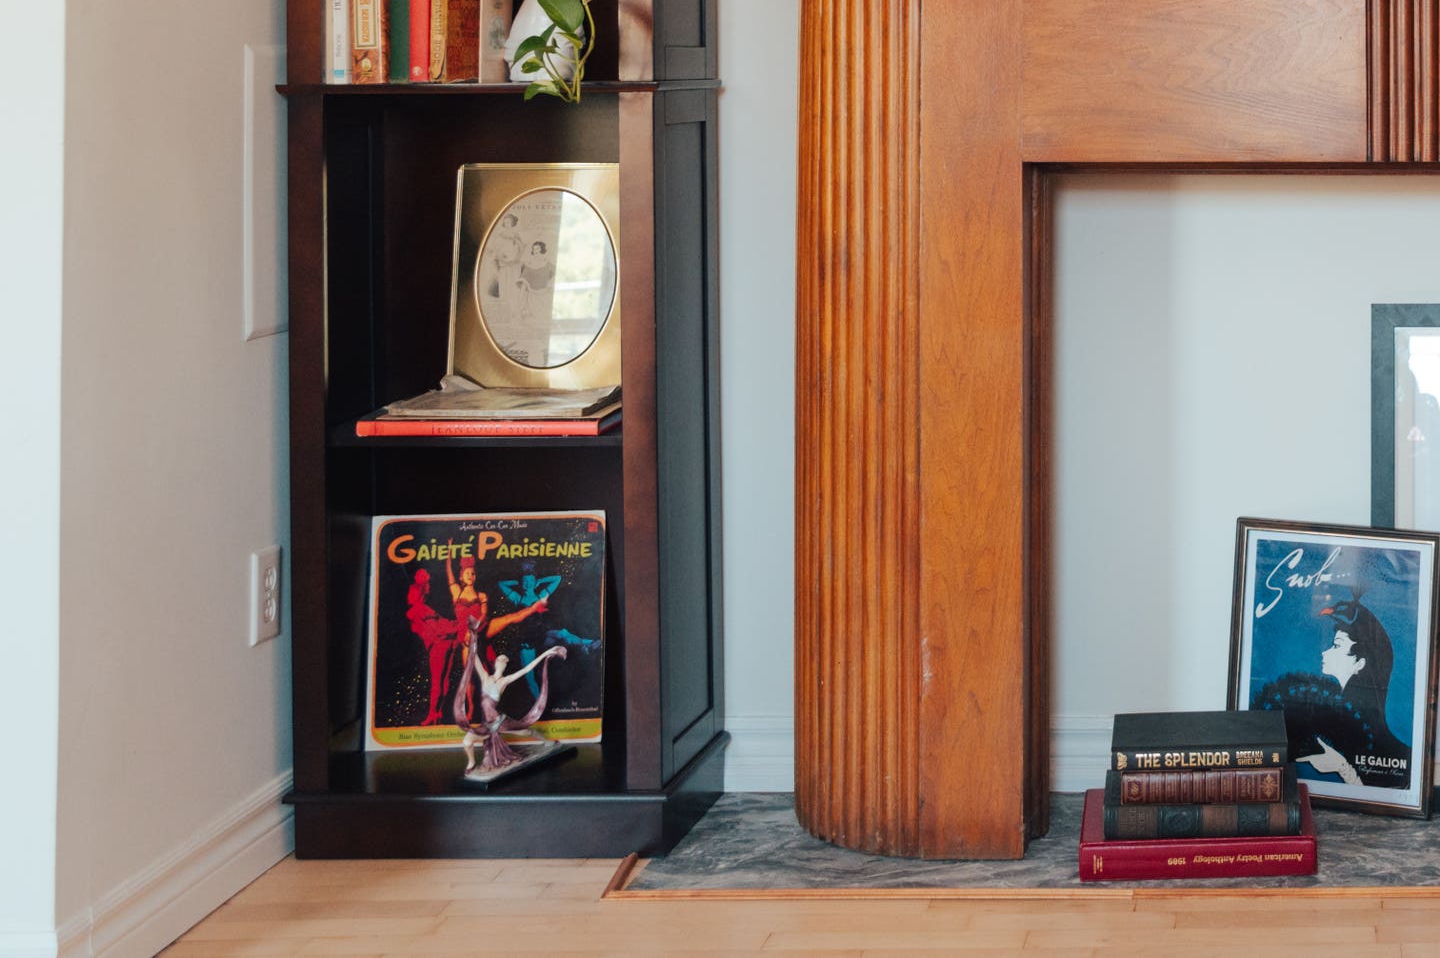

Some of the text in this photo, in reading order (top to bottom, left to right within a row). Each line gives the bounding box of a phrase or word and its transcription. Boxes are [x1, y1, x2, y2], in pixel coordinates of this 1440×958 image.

[1135, 751, 1231, 768] THE SPLENDOR
[1355, 755, 1407, 769] LE GALION
[1167, 852, 1304, 865] American Poetry Anthology 1989
